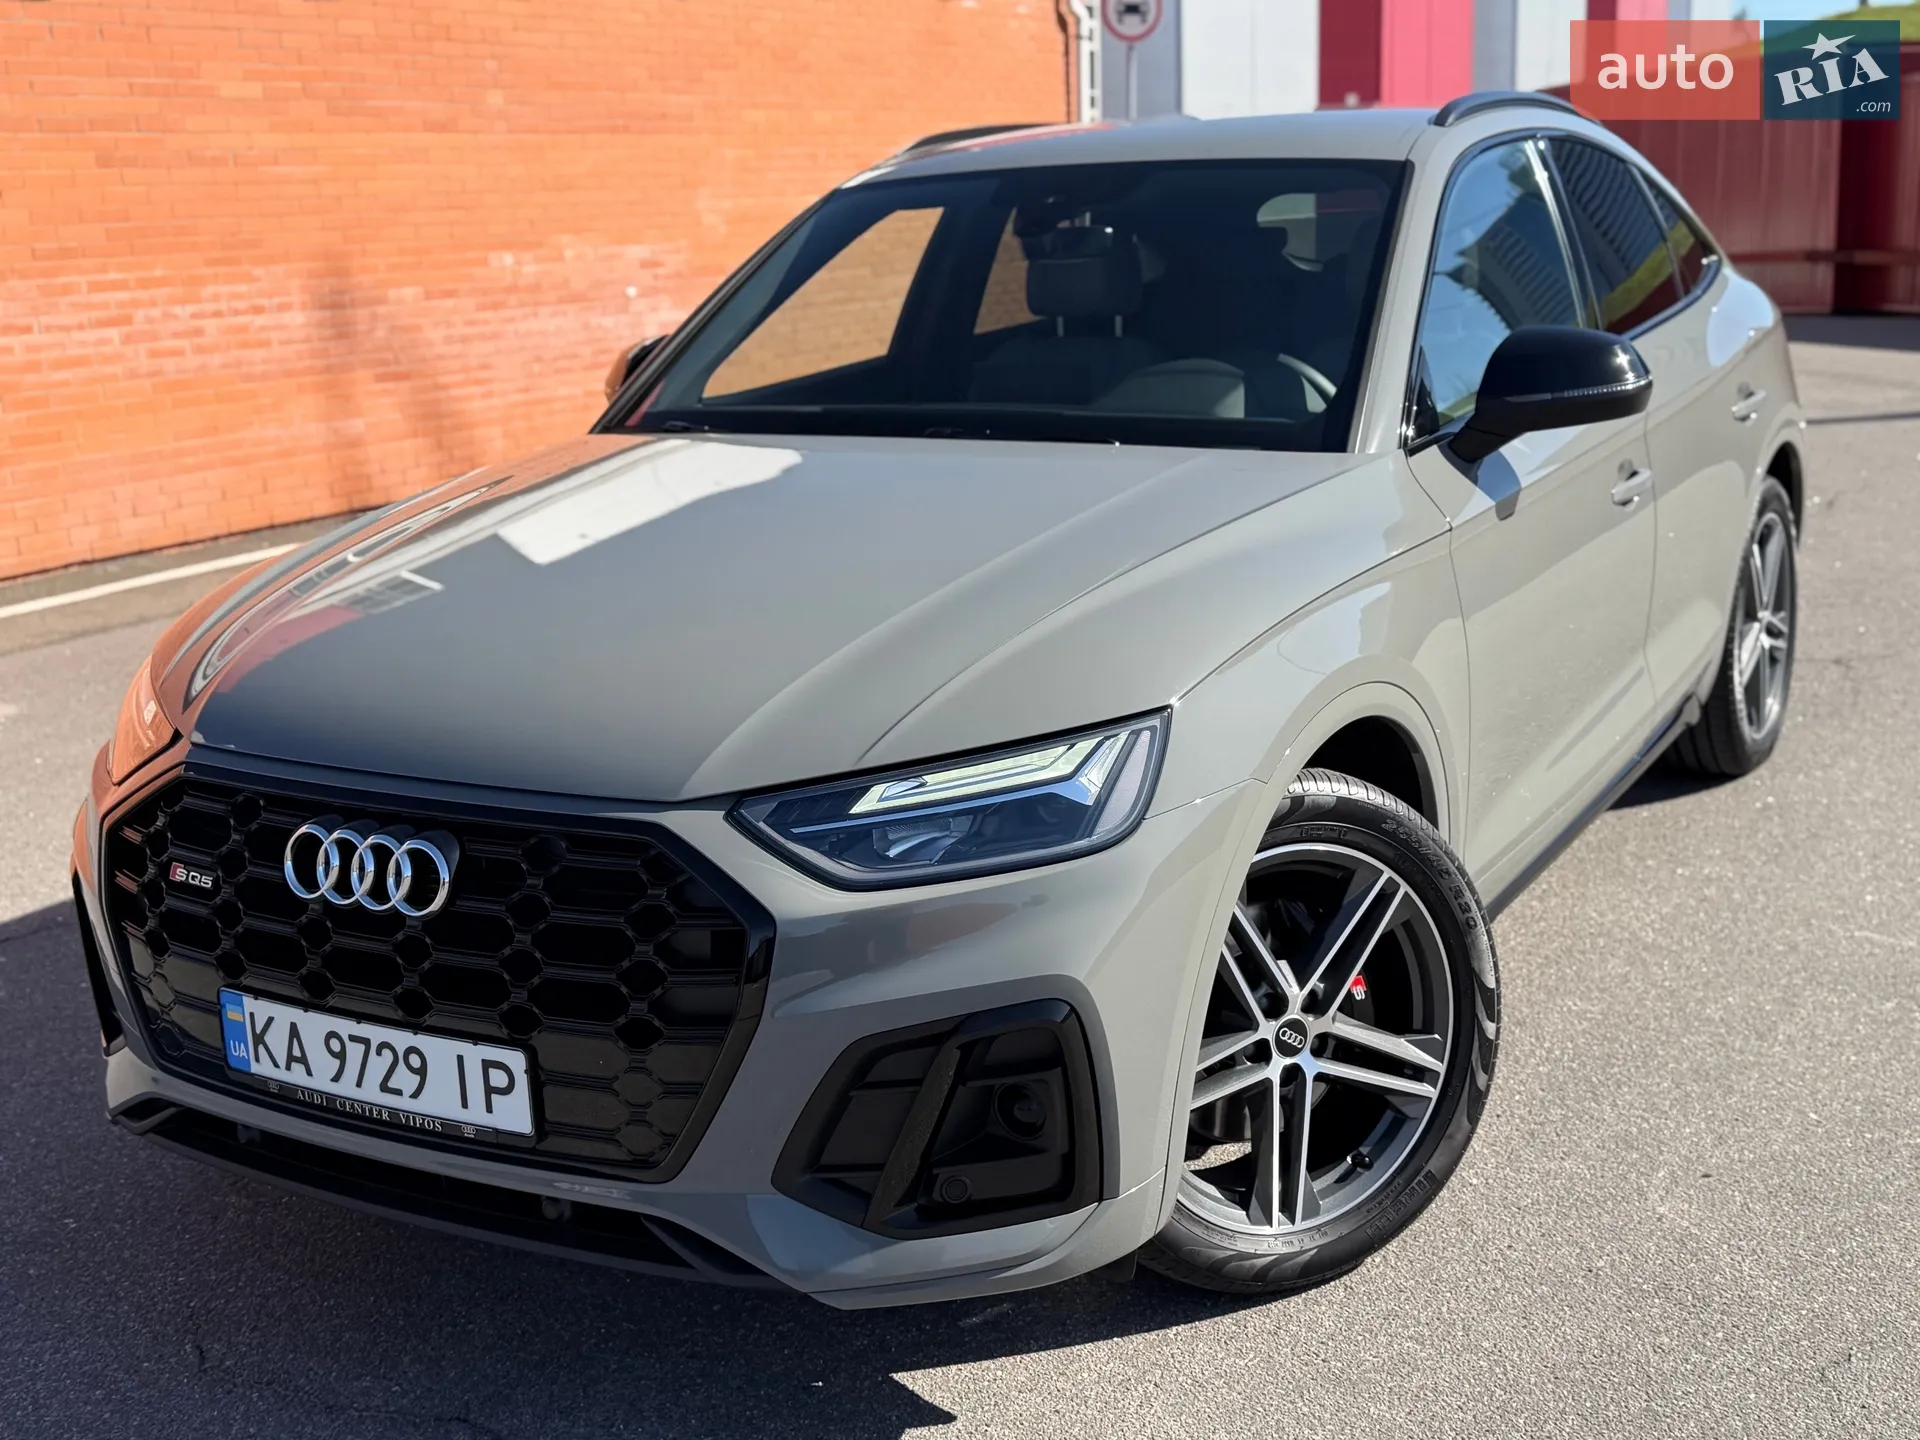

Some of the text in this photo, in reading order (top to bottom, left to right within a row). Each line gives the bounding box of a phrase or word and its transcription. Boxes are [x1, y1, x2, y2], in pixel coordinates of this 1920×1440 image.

[173, 866, 213, 888] SQ5
[230, 1039, 248, 1060] UA
[249, 1011, 516, 1114] KA 9729 IP
[296, 1089, 442, 1132] AUDI CENTER VIPOS
